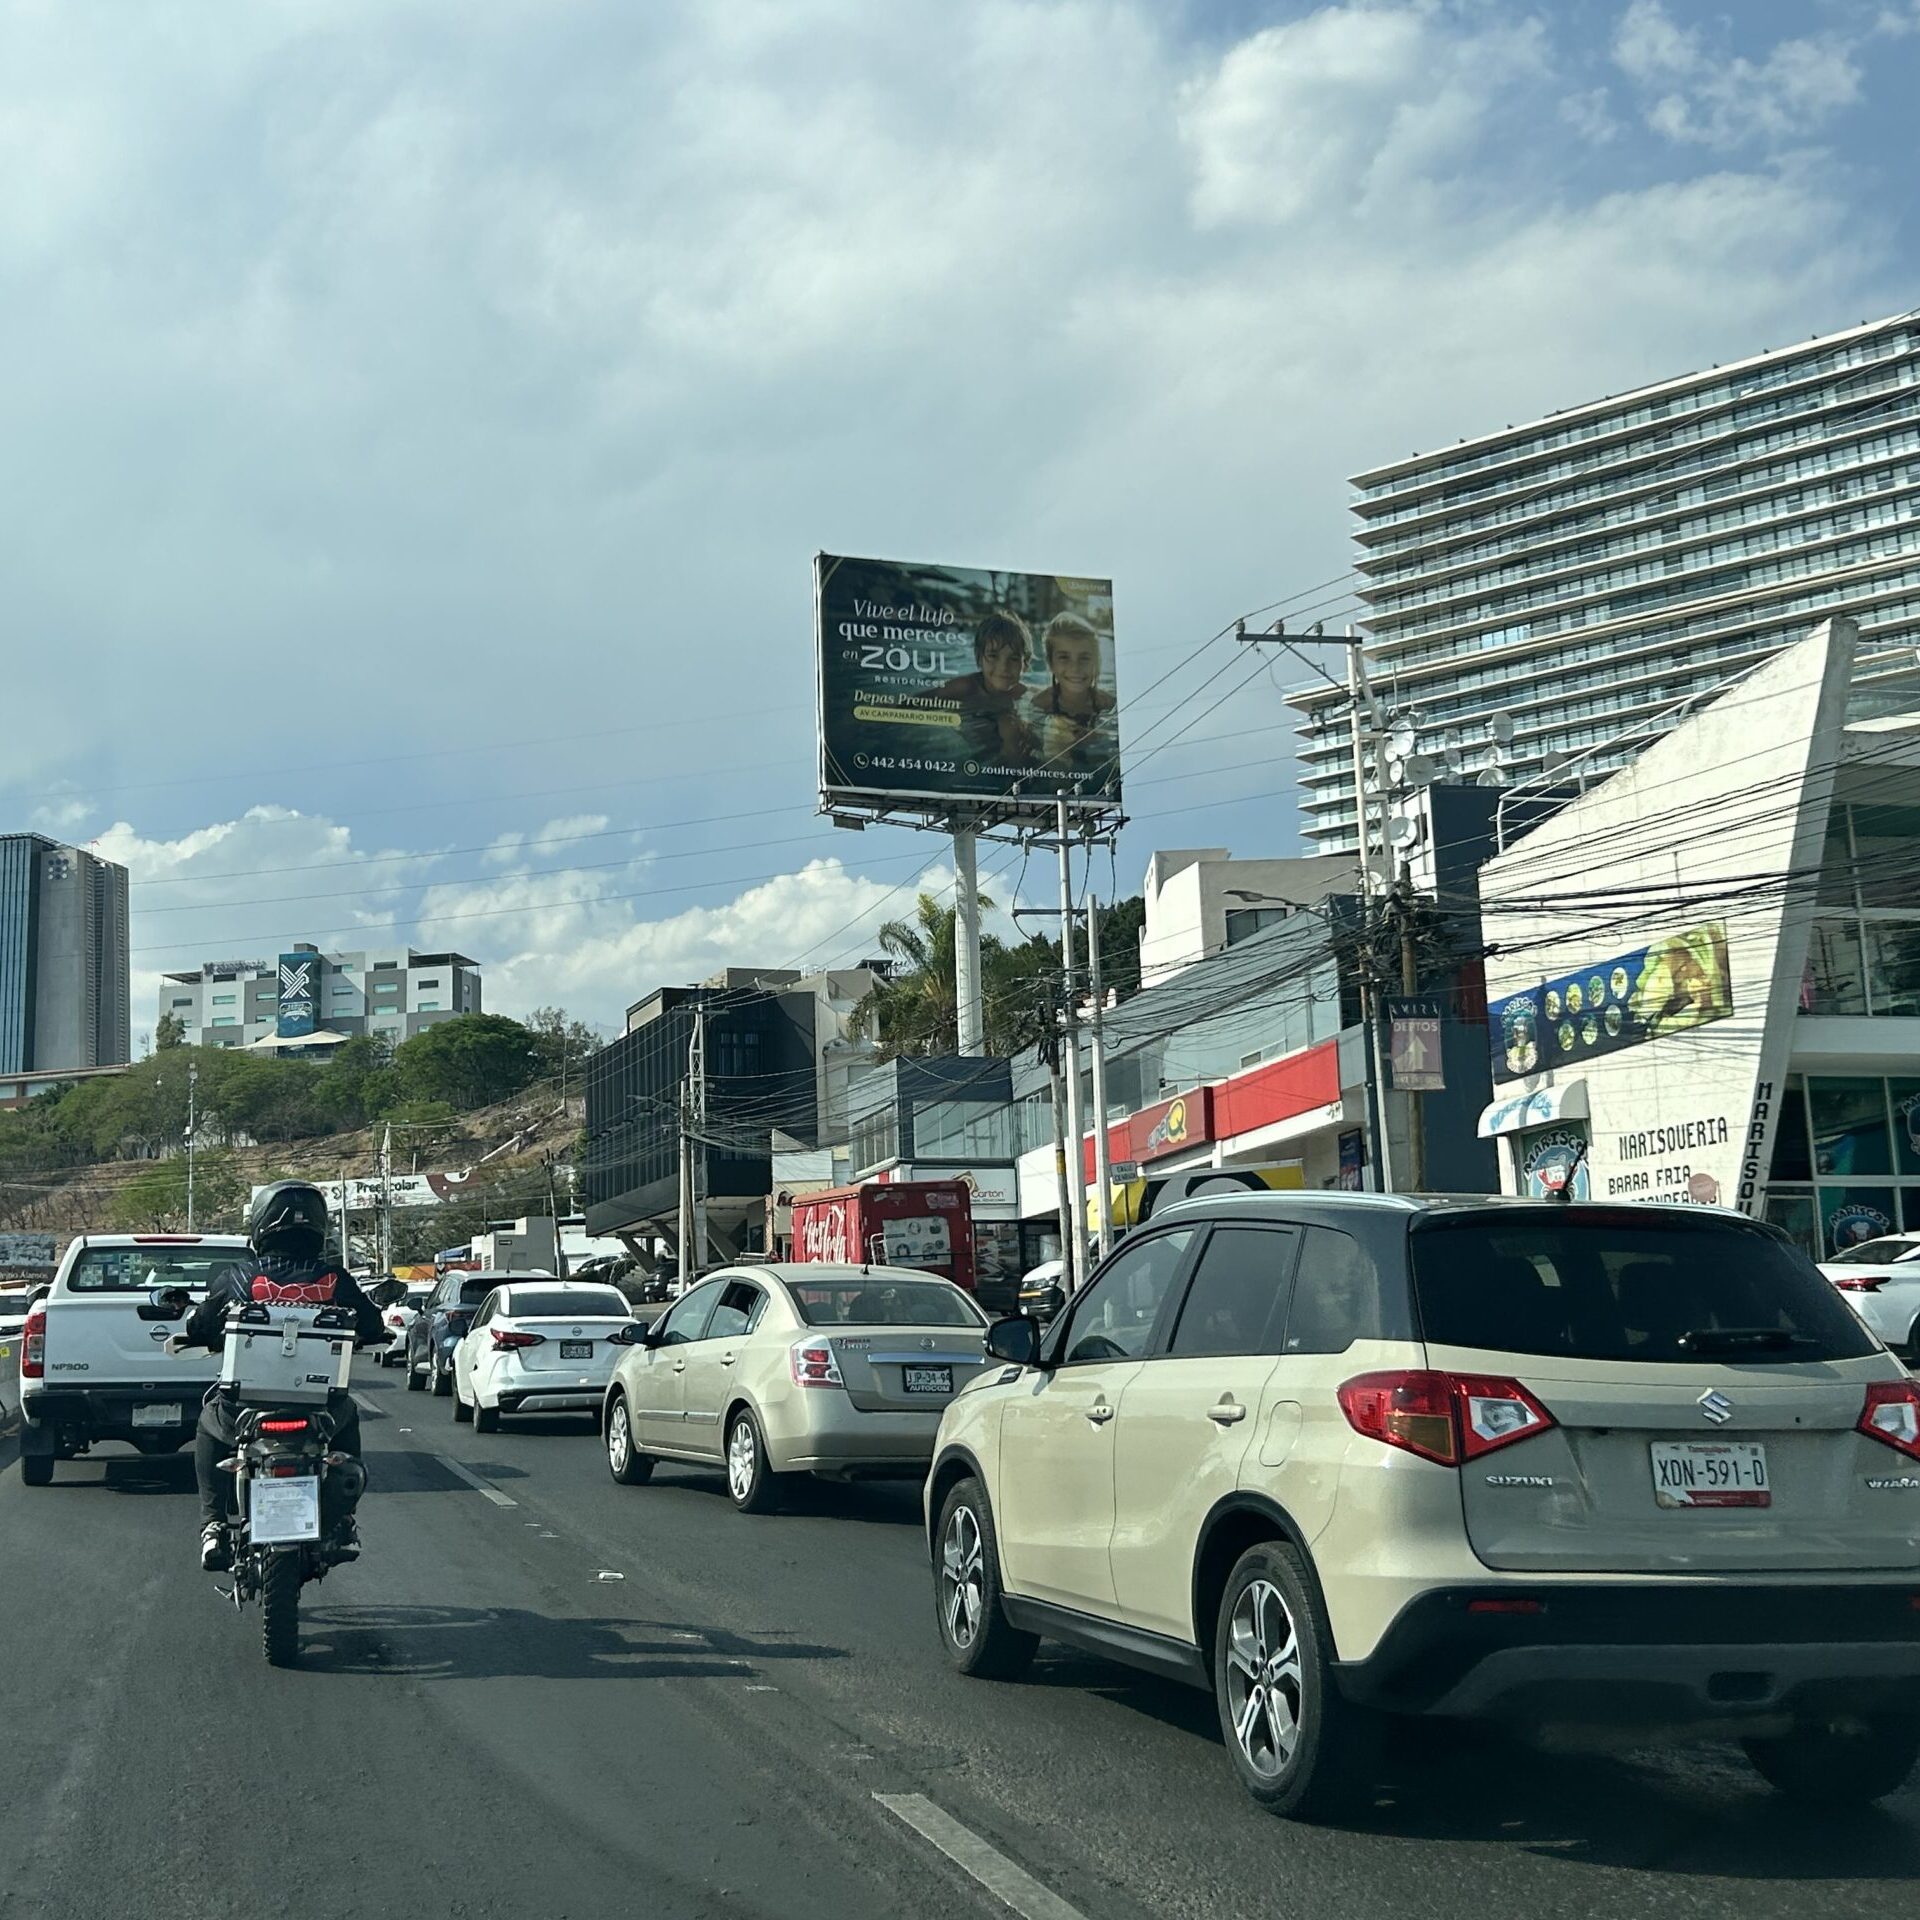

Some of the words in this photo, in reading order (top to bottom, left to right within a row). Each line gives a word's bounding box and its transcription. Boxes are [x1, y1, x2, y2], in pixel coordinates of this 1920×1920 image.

[854, 599, 894, 620] Vive
[898, 604, 914, 622] el
[920, 605, 954, 627] lujo
[838, 622, 878, 642] que
[884, 626, 968, 646] mereces
[842, 649, 858, 660] en
[854, 689, 895, 706] Depas
[898, 693, 963, 710] Premium
[871, 711, 924, 721] CAMPANARIO
[926, 714, 953, 723] NORTE
[871, 756, 895, 769] 442
[898, 758, 922, 770] 454
[924, 760, 956, 773] 0422
[980, 766, 1093, 781] zoulresidences.com
[1393, 1022, 1438, 1032] DEPTOS
[1619, 1116, 1728, 1161] MARISQUERIA
[356, 1179, 419, 1194] Preecolar
[1608, 1172, 1649, 1195] BARRA
[1656, 1165, 1690, 1187] FRIA
[1829, 1205, 1890, 1228] MARISCOS
[51, 1363, 89, 1371] NP300
[1485, 1475, 1552, 1487] SUZUKI
[1658, 1459, 1764, 1486] XDN-591-D
